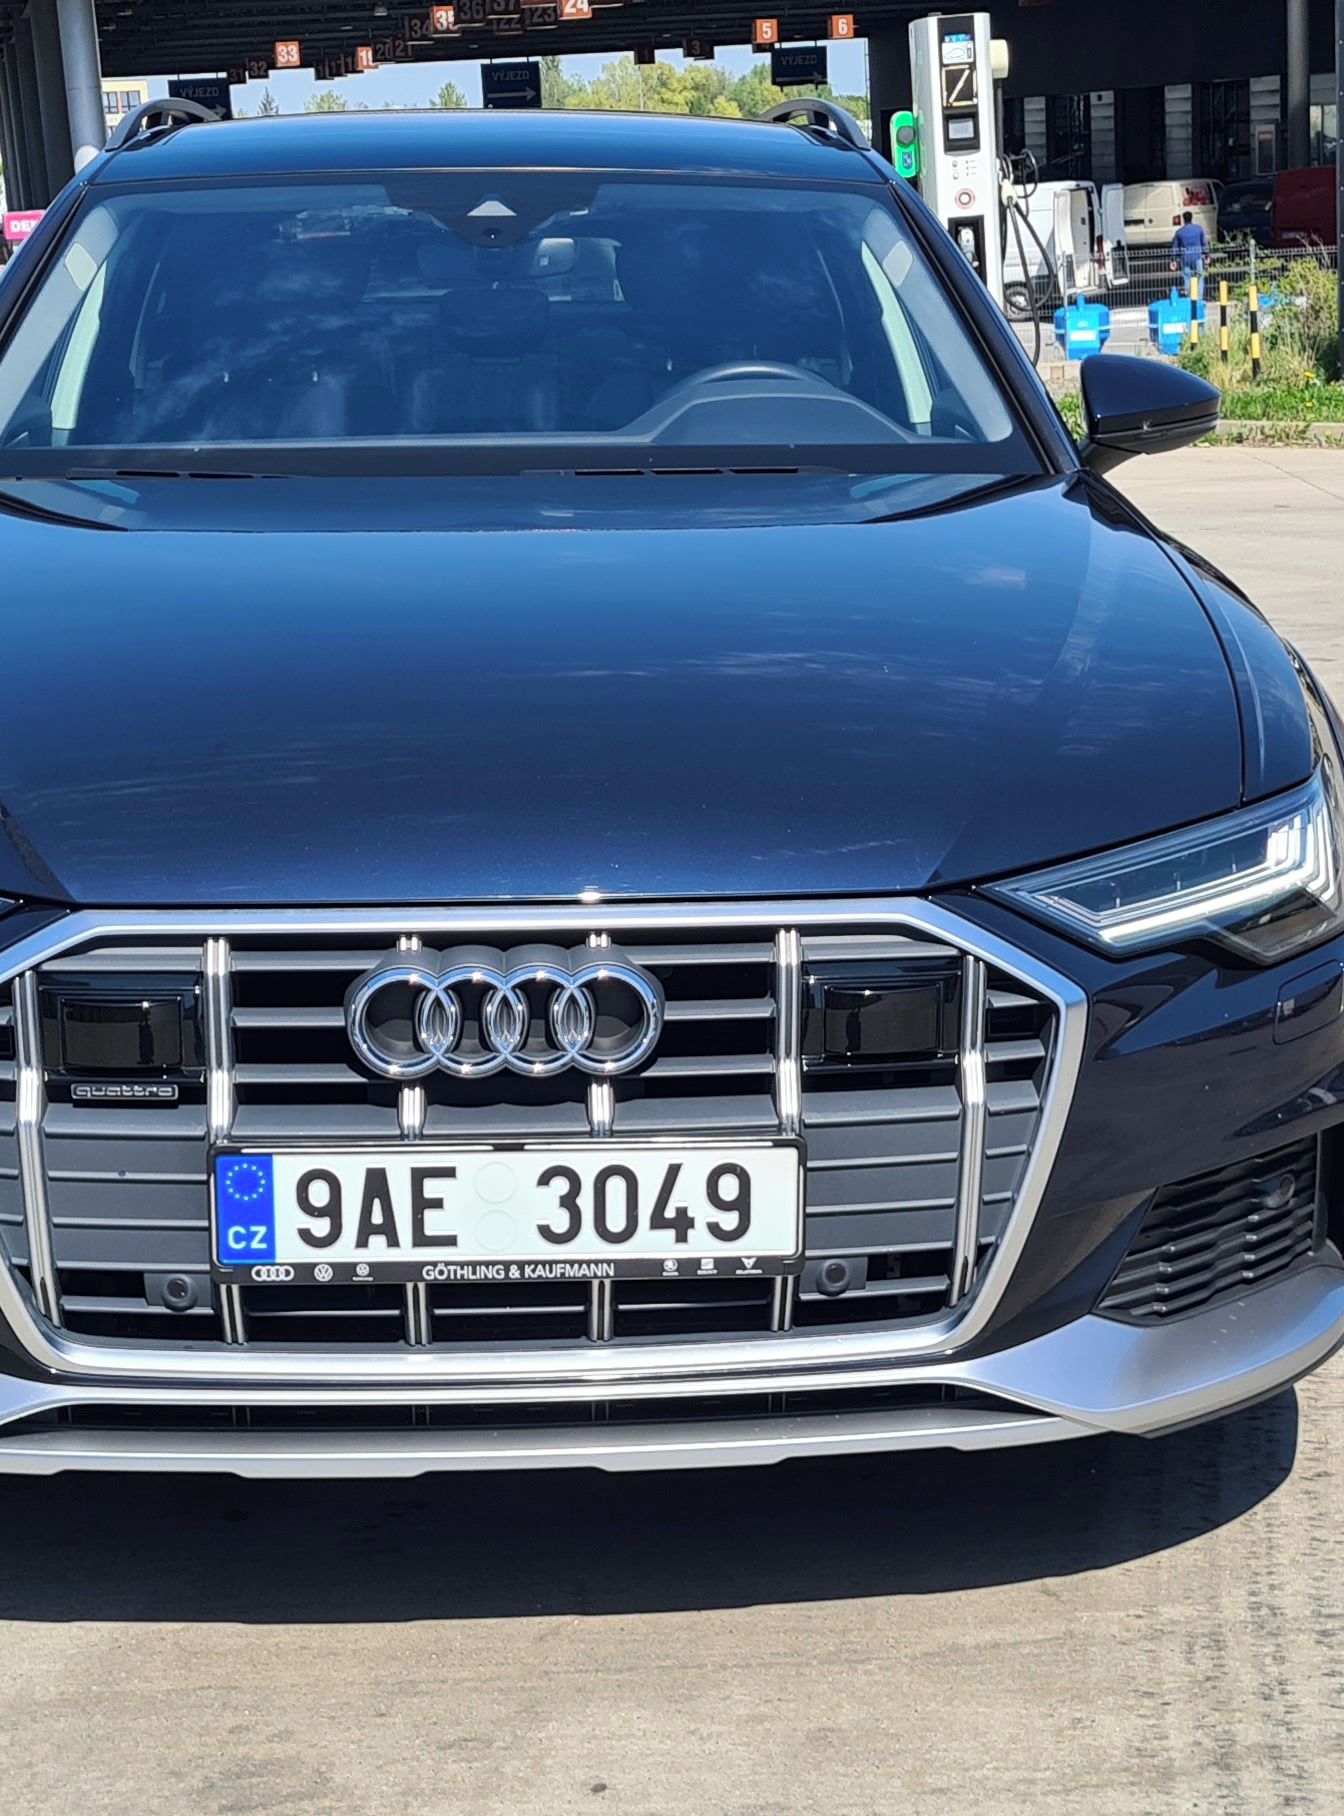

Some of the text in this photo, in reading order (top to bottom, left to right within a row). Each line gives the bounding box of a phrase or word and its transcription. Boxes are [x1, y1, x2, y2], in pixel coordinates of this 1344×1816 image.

[460, 0, 484, 19] 36
[563, 0, 590, 14] 24
[410, 18, 431, 39] 34
[761, 22, 772, 39] 5
[837, 18, 848, 35] 6
[276, 44, 299, 63] 33
[375, 44, 393, 60] 20
[691, 39, 701, 55] 3
[249, 60, 267, 76] 32
[490, 69, 531, 81] VÝJEZD
[179, 86, 220, 98] VÝJEZD
[75, 1084, 173, 1098] quattro
[295, 1162, 752, 1249] 9AE 3049
[227, 1225, 268, 1249] CZ
[422, 1262, 615, 1281] GÖTHLING & KAUFMANN
